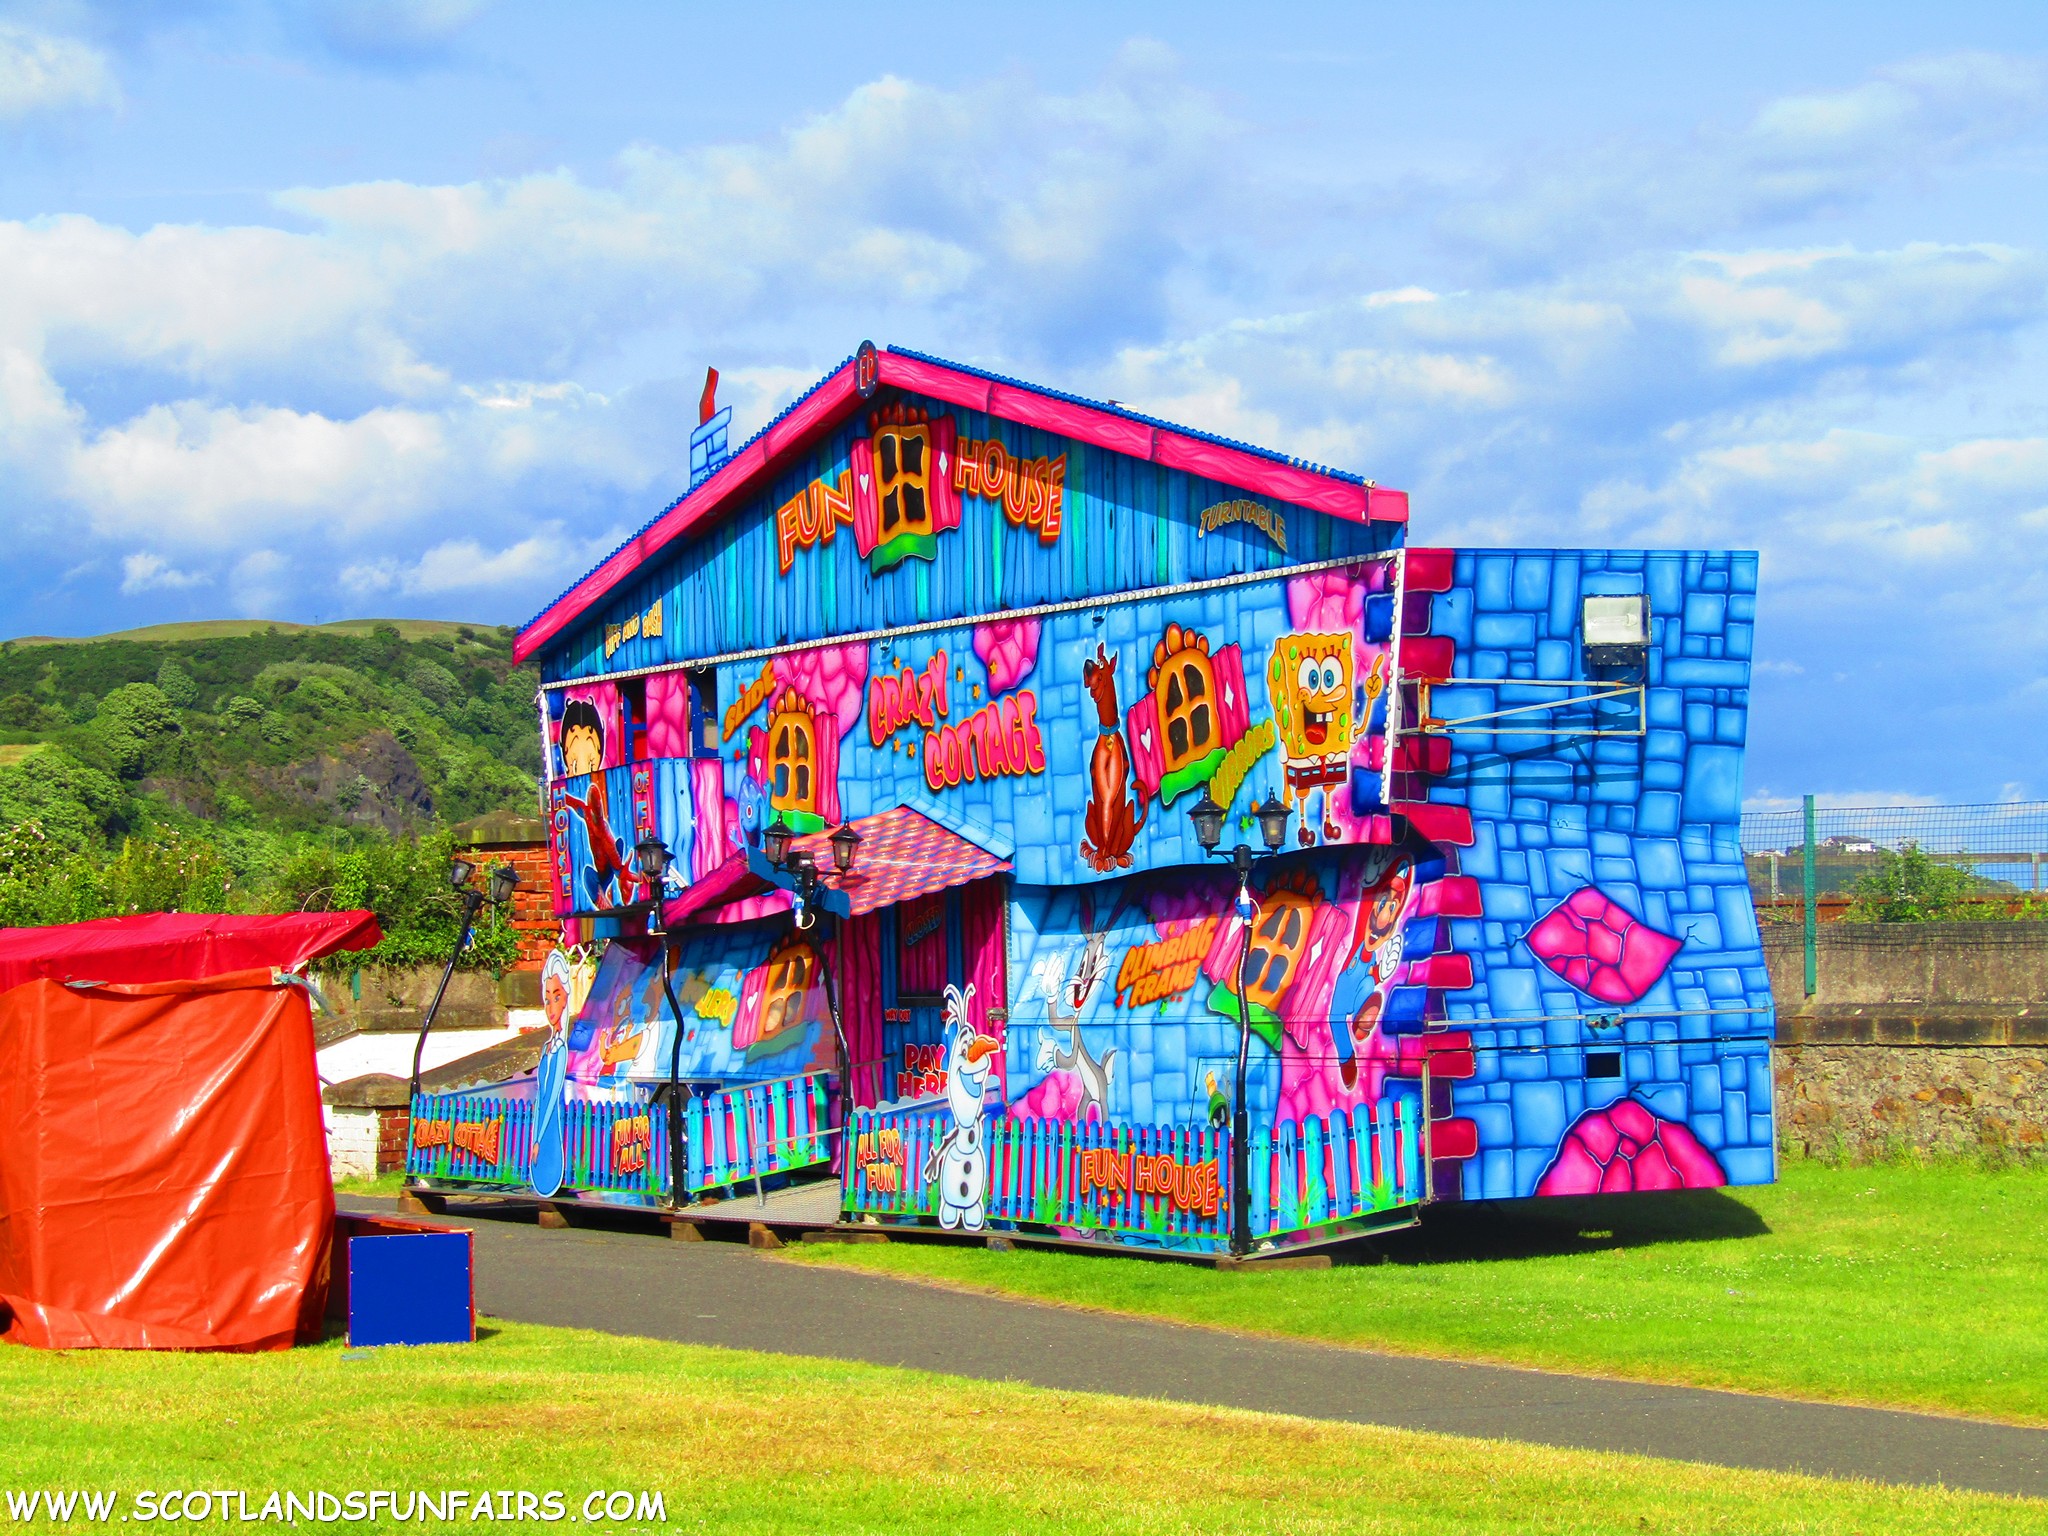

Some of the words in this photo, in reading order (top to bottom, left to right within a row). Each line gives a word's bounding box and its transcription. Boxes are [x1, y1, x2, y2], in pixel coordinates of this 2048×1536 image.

[776, 469, 854, 577] FUN
[954, 436, 1067, 543] HOUSE
[1198, 499, 1288, 553] TURNTABLE
[722, 659, 777, 743] SLIDE
[869, 648, 949, 747] CRAZY
[924, 689, 1047, 790] COTTAGE
[634, 771, 649, 794] OF
[553, 786, 572, 896] HOUSE
[1116, 913, 1218, 993] CLIMBING
[1128, 959, 1201, 1009] FRAME
[904, 1043, 946, 1072] PAY
[898, 1071, 948, 1099] HERE
[415, 1118, 450, 1148] CRAZY
[453, 1119, 500, 1165] COTTAGE
[614, 1117, 631, 1167] FUN
[632, 1115, 651, 1151] FOR
[618, 1143, 645, 1177] ALL
[857, 1132, 878, 1169] ALL
[878, 1128, 904, 1165] FOR
[866, 1162, 897, 1192] FUN
[1081, 1148, 1129, 1194] FUN
[1135, 1154, 1218, 1217] HOUSE
